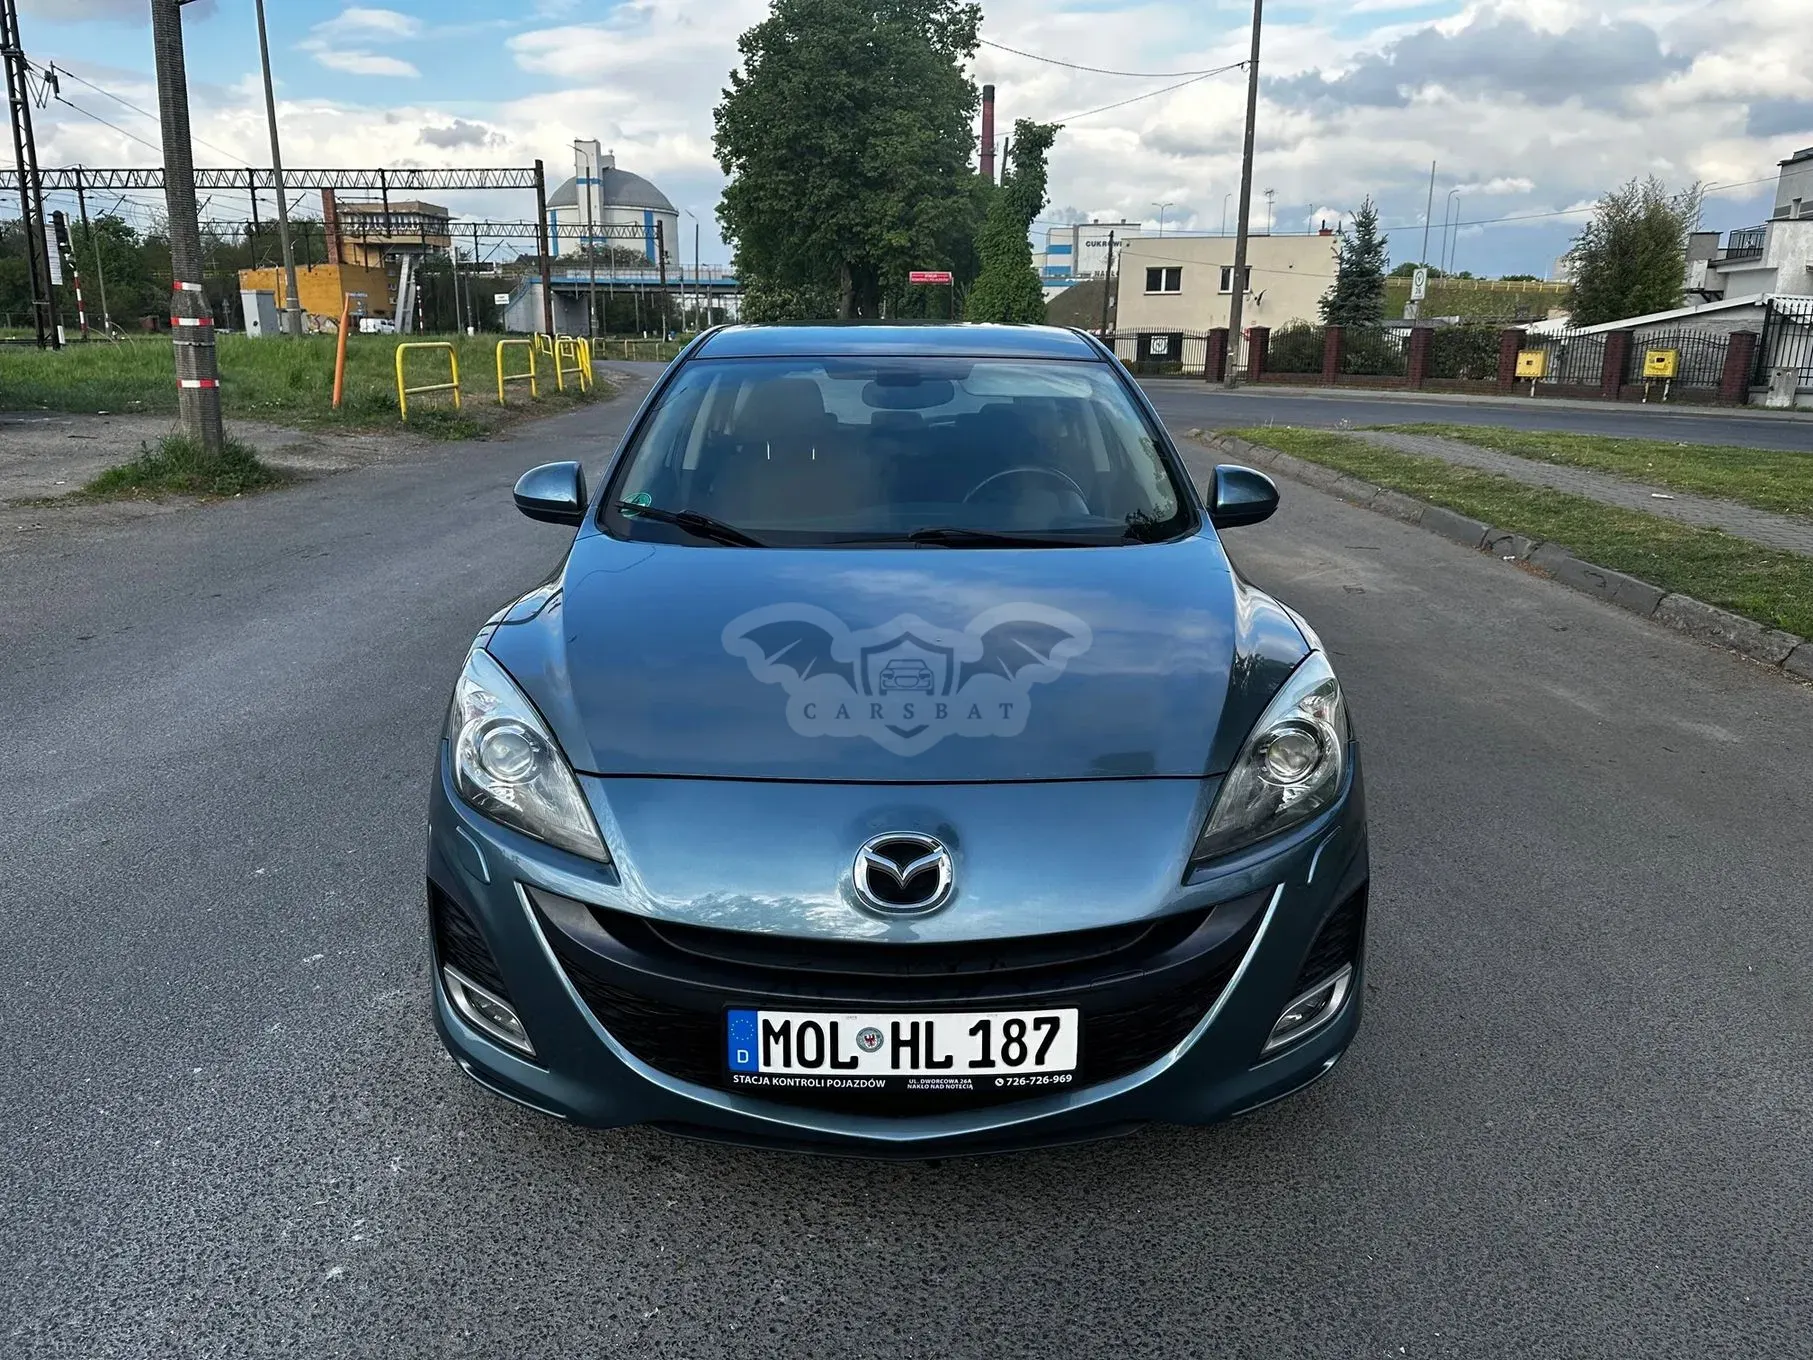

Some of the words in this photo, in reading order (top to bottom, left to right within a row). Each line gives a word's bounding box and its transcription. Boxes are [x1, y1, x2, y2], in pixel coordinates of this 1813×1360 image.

[762, 1018, 859, 1069] MOL
[891, 1020, 953, 1069] HL
[969, 1016, 1061, 1069] 187
[737, 1049, 749, 1064] D
[733, 1074, 770, 1085] STACJA
[772, 1077, 824, 1087] KONTROLI
[827, 1077, 886, 1088] POJAZDÓW
[1006, 1074, 1073, 1086] 726-726-969
